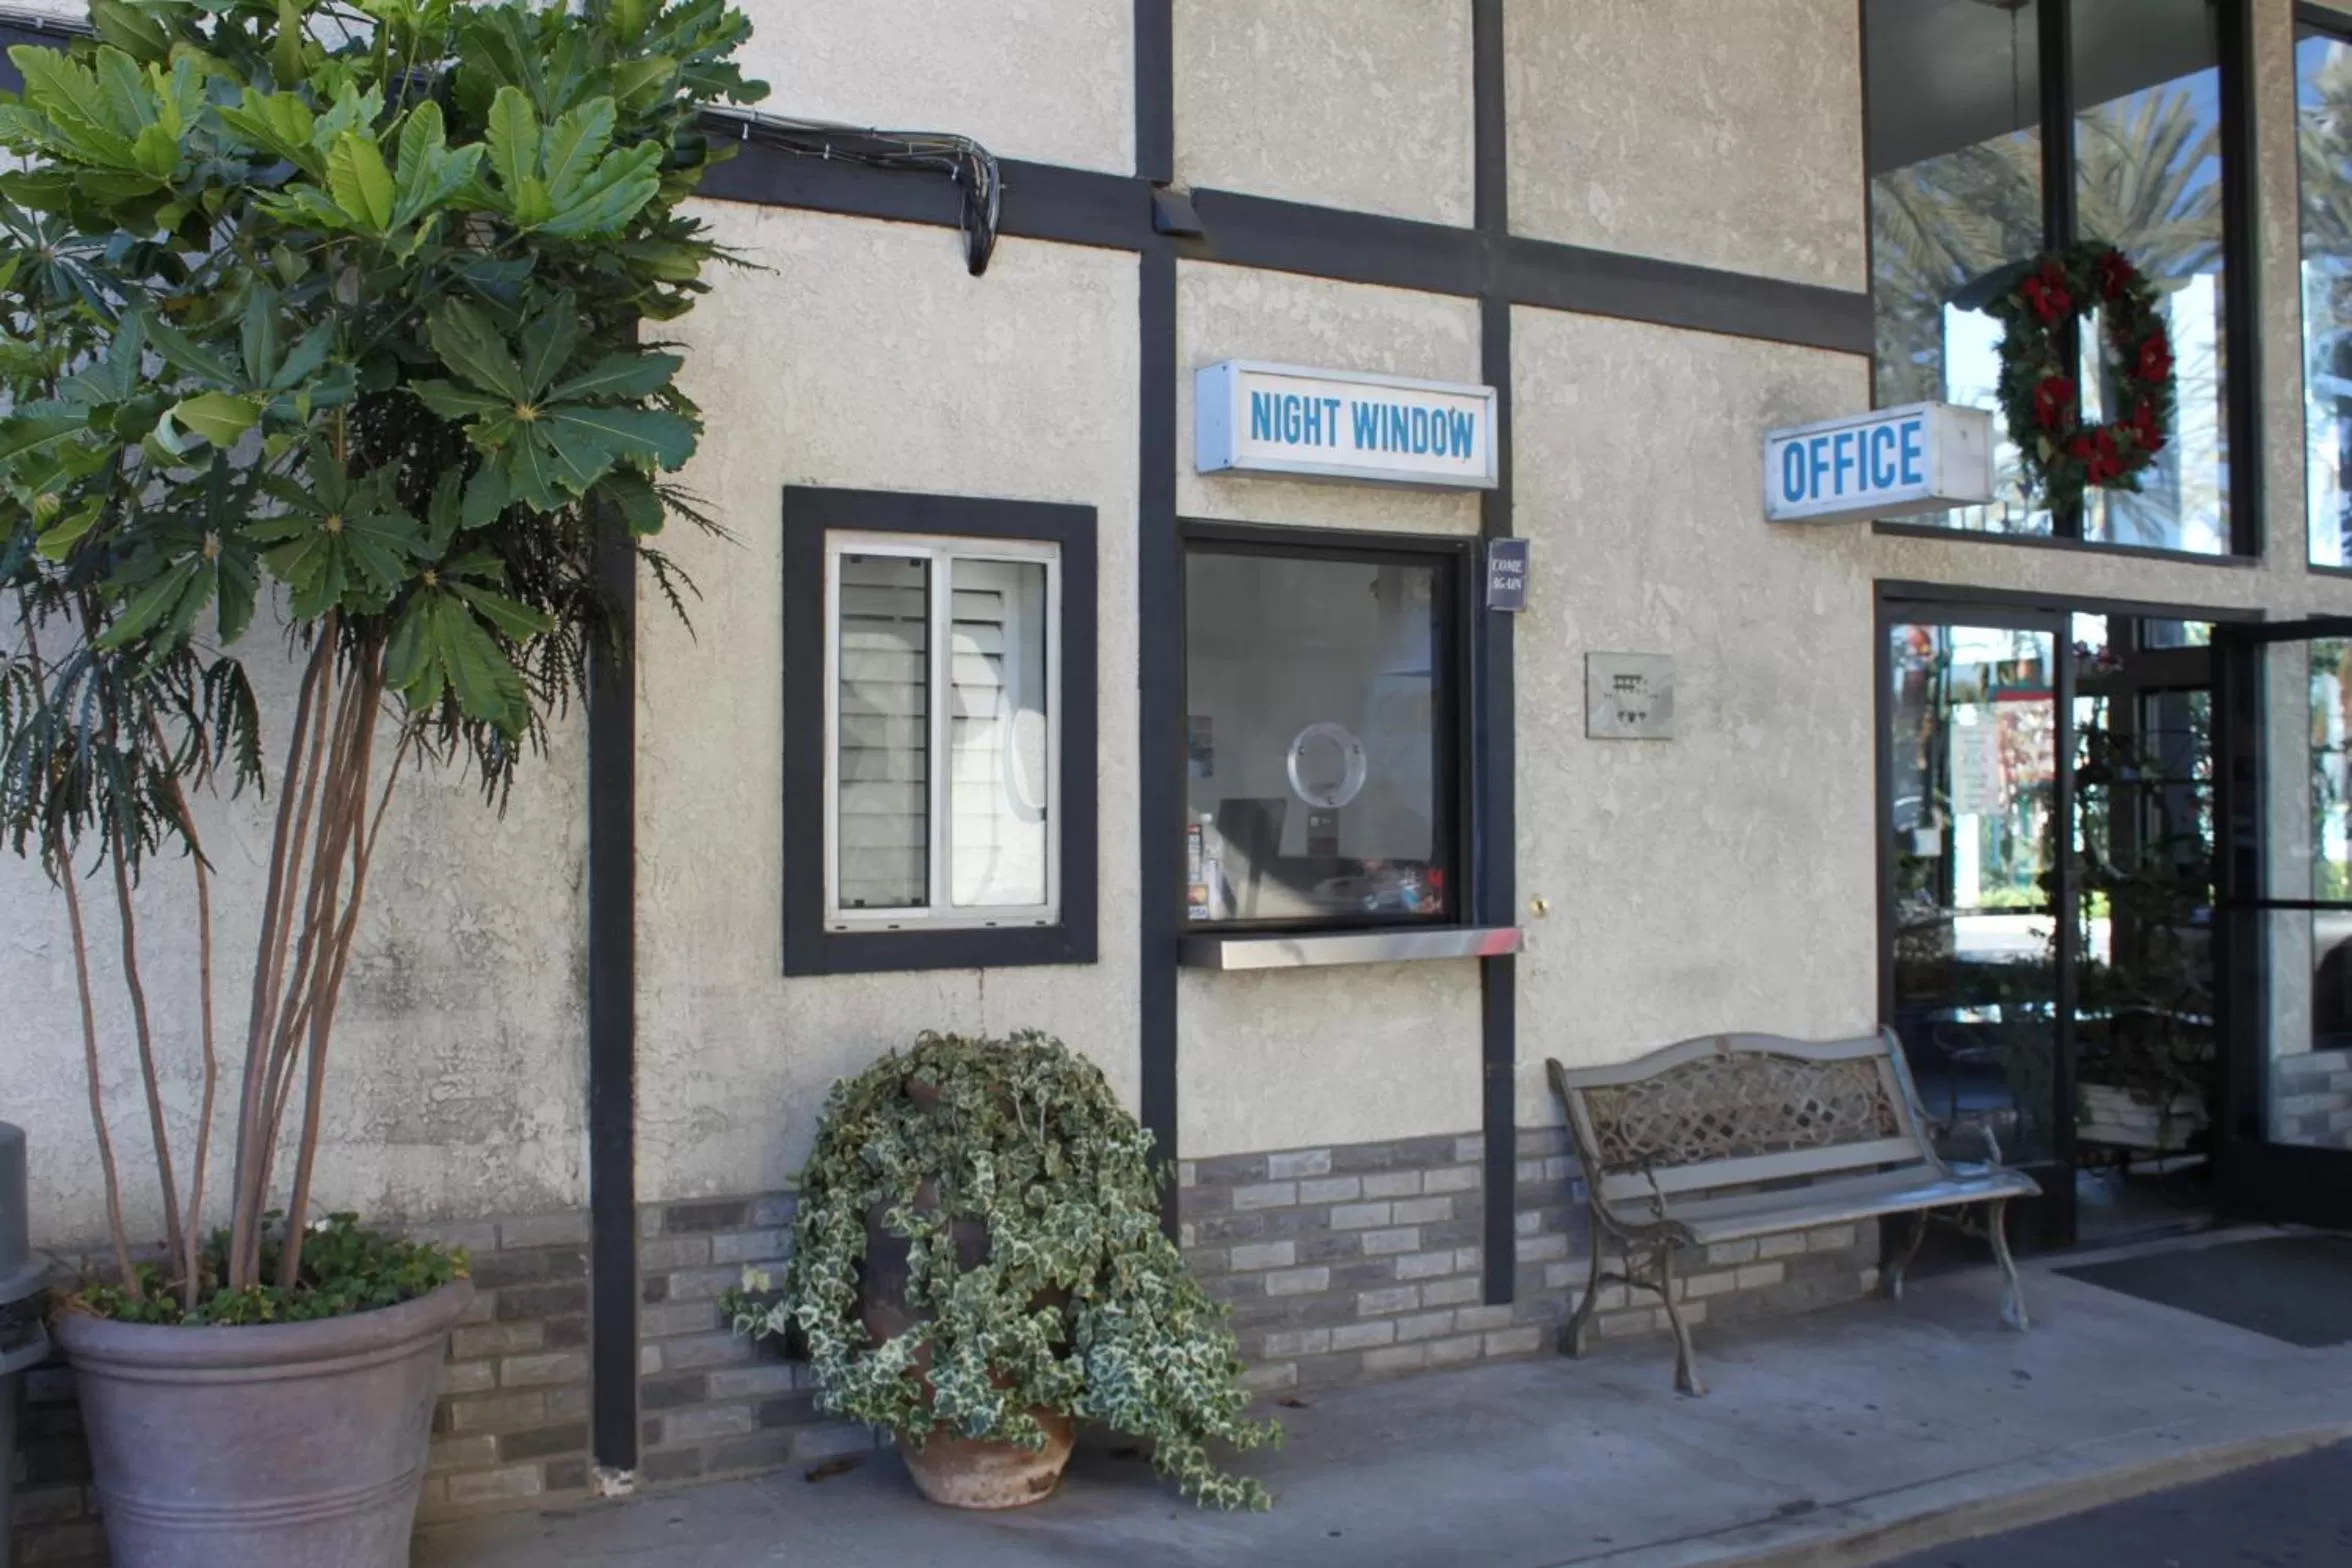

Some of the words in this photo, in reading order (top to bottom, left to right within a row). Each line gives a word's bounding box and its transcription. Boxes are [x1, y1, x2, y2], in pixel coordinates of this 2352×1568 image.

[1251, 391, 1341, 447] NIGHT
[1352, 400, 1474, 459] WINDOW
[1782, 420, 1923, 502] OFFICE
